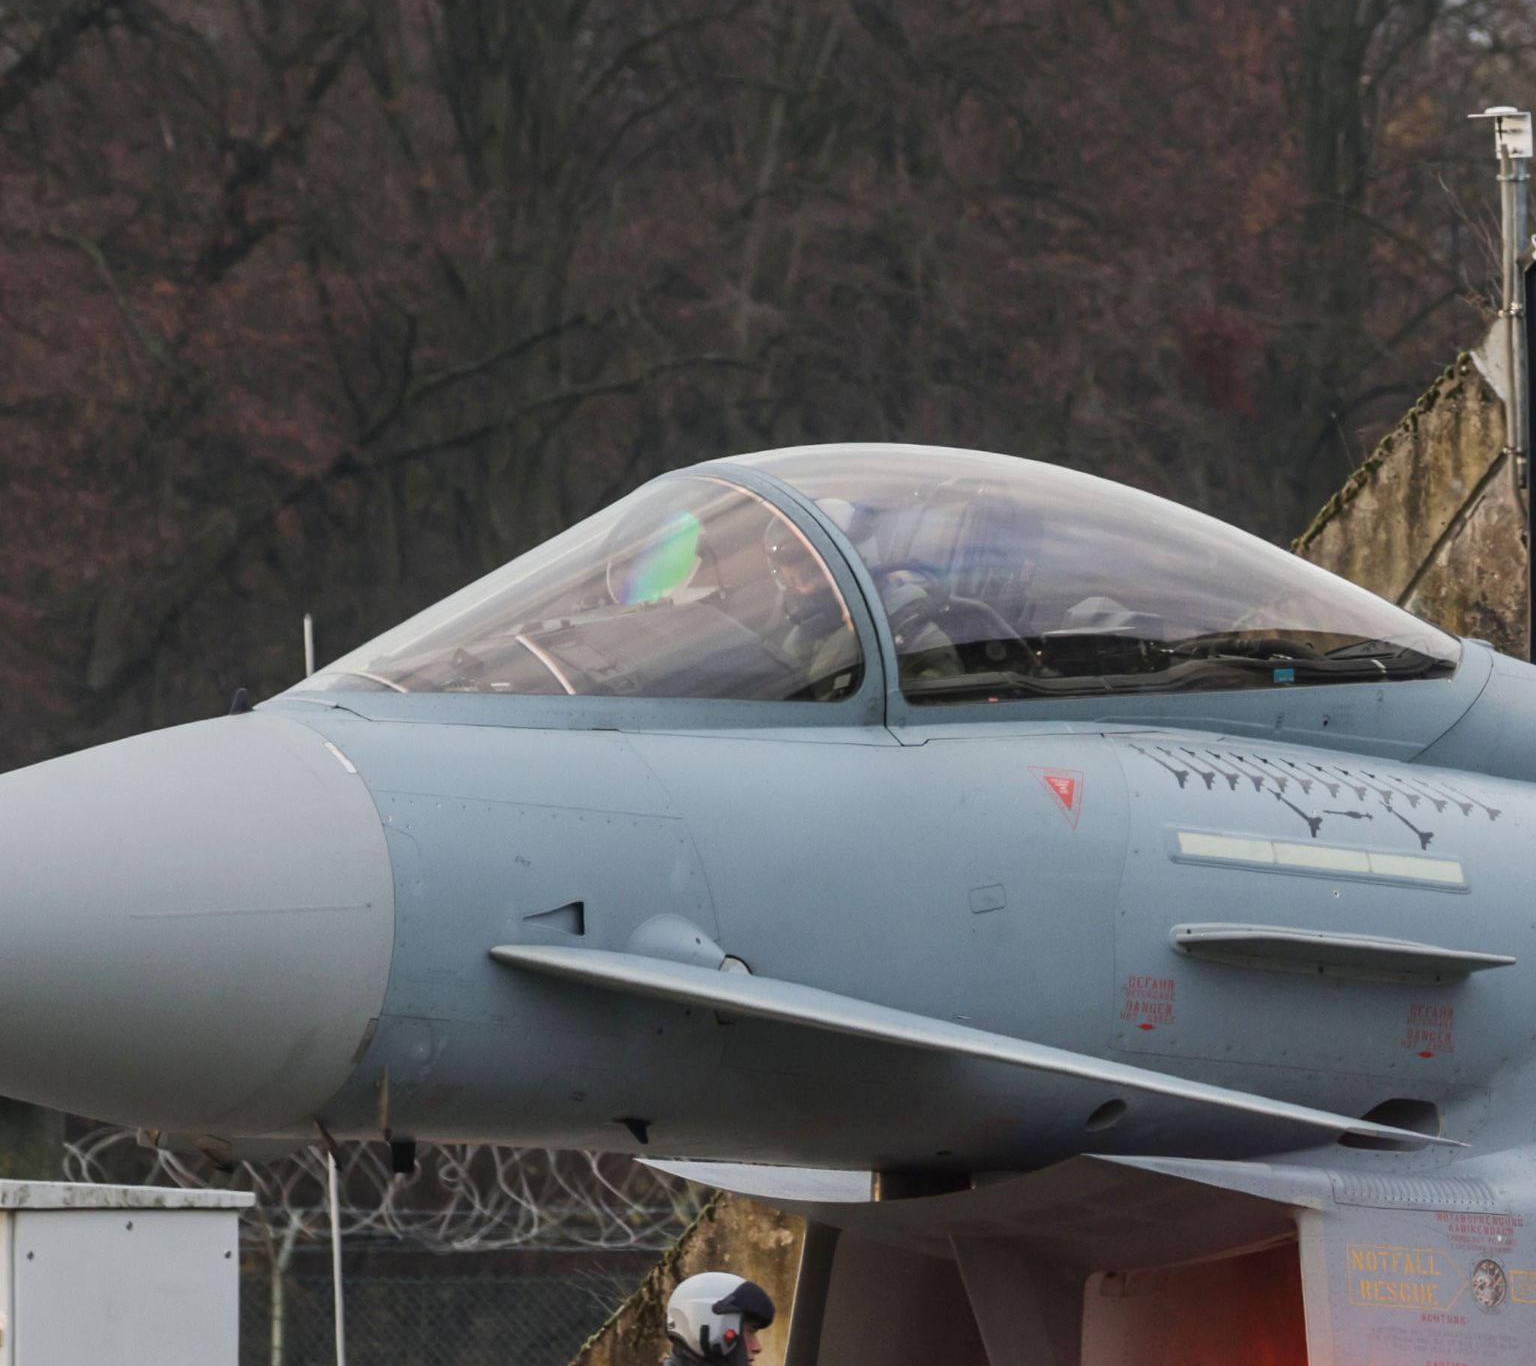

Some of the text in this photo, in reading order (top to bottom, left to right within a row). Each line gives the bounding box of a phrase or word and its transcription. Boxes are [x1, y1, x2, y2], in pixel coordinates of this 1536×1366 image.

[1126, 1000, 1173, 1016] DANGER
[1350, 1249, 1441, 1276] NOTFALL
[1359, 1280, 1440, 1306] RESCUE
